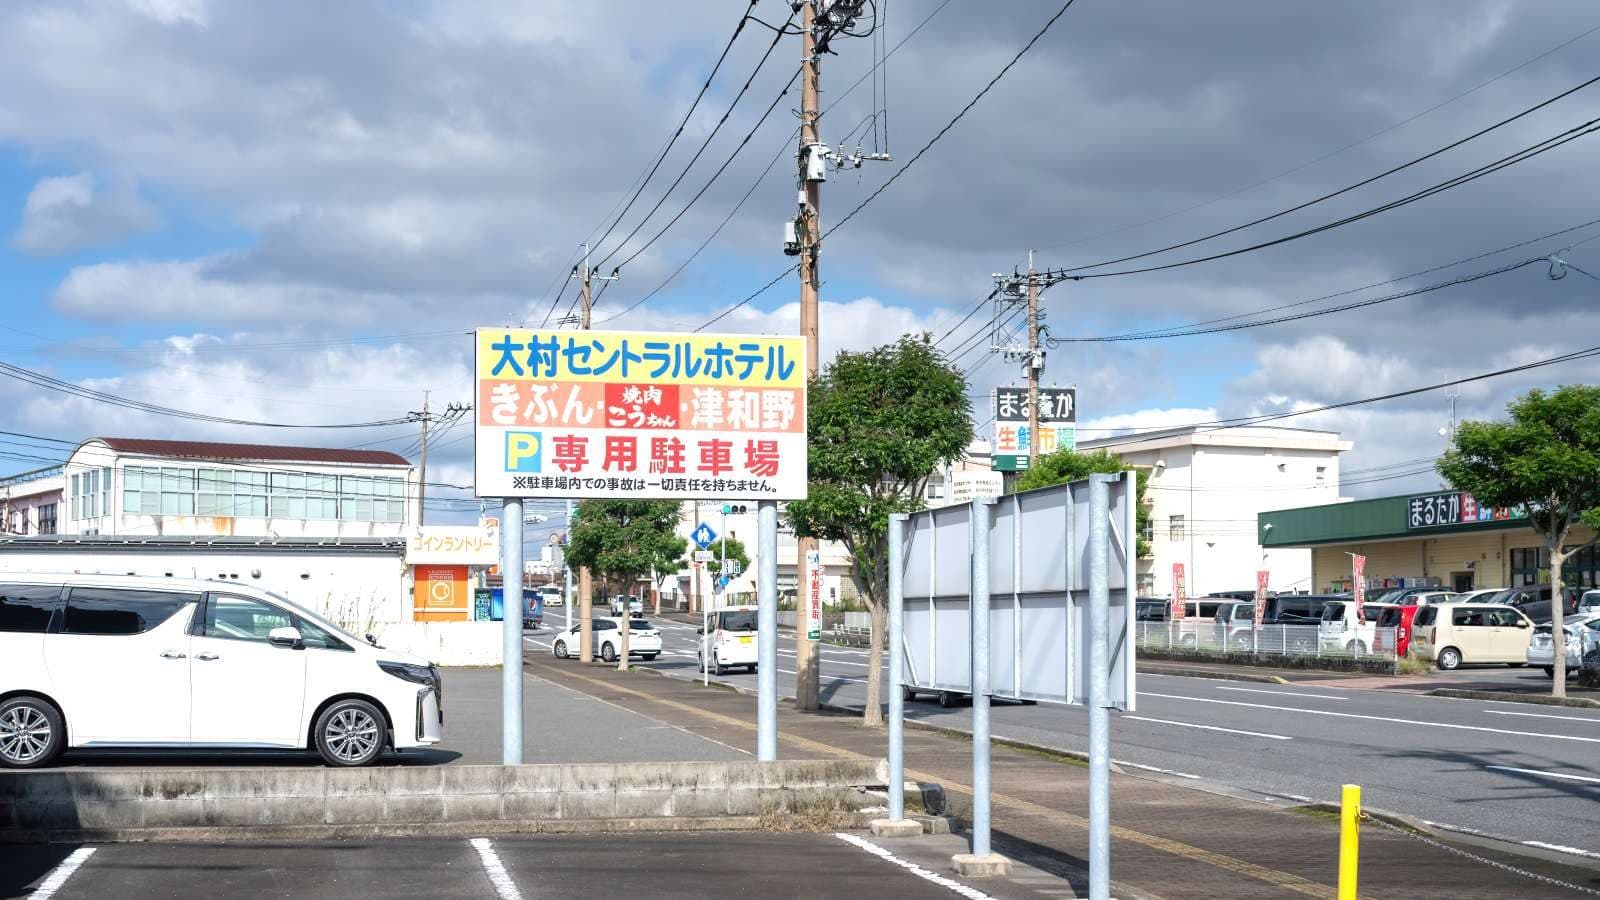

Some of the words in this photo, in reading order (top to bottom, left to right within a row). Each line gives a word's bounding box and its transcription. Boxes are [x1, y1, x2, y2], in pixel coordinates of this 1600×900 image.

[490, 334, 796, 381] 大村セントラルホテル
[621, 385, 663, 406] 焼肉
[607, 404, 677, 429] こうちゃん
[507, 434, 540, 470] P
[550, 434, 781, 478] 専用駐車場
